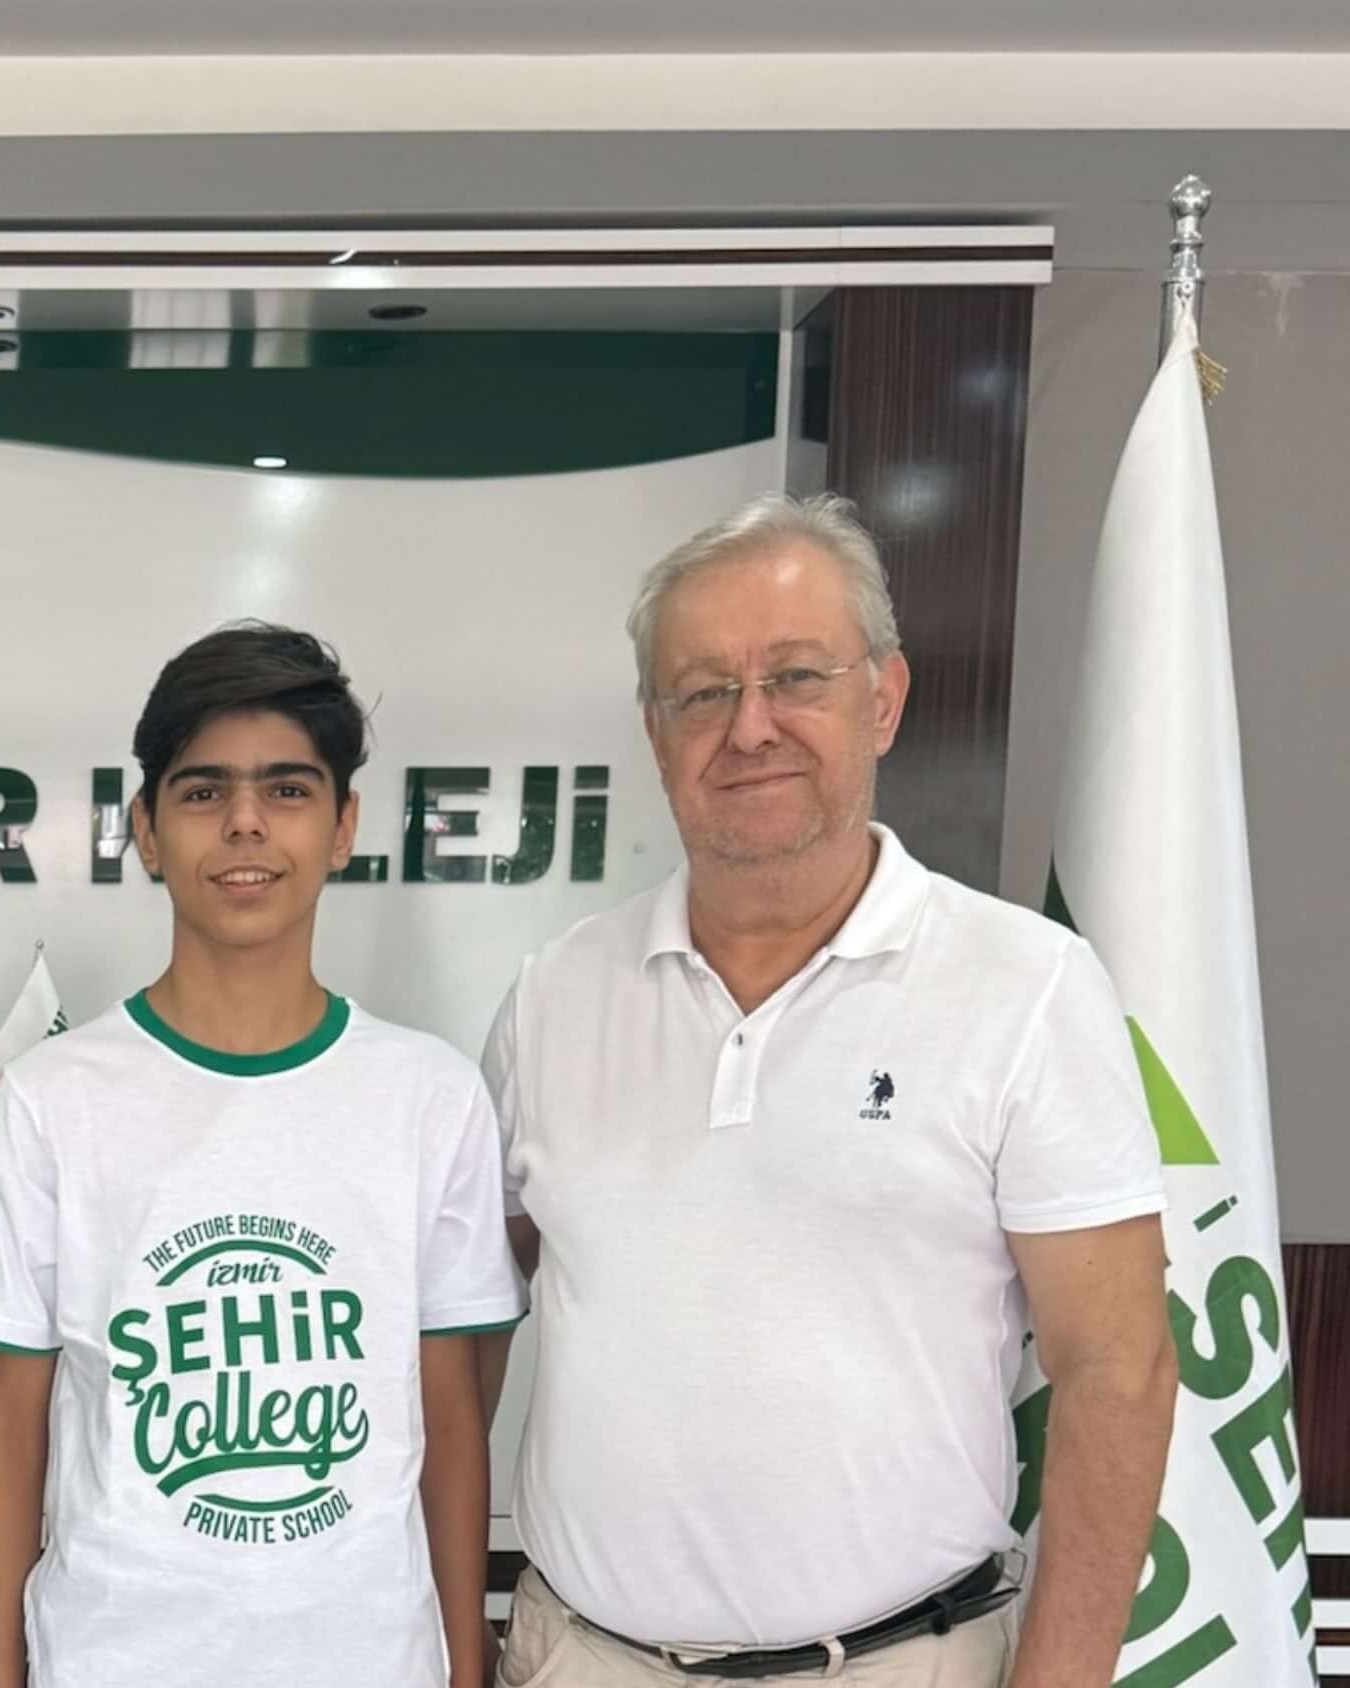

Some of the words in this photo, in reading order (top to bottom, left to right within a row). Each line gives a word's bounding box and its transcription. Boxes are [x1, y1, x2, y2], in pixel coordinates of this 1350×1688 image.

[143, 1239, 177, 1272] THE
[173, 1214, 235, 1253] FUTURE
[238, 1214, 296, 1241] BEGINS
[299, 1226, 336, 1265] HERE
[134, 1370, 369, 1492] College
[183, 1501, 276, 1544] PRIVATE
[282, 1489, 353, 1541] SCHOOL
